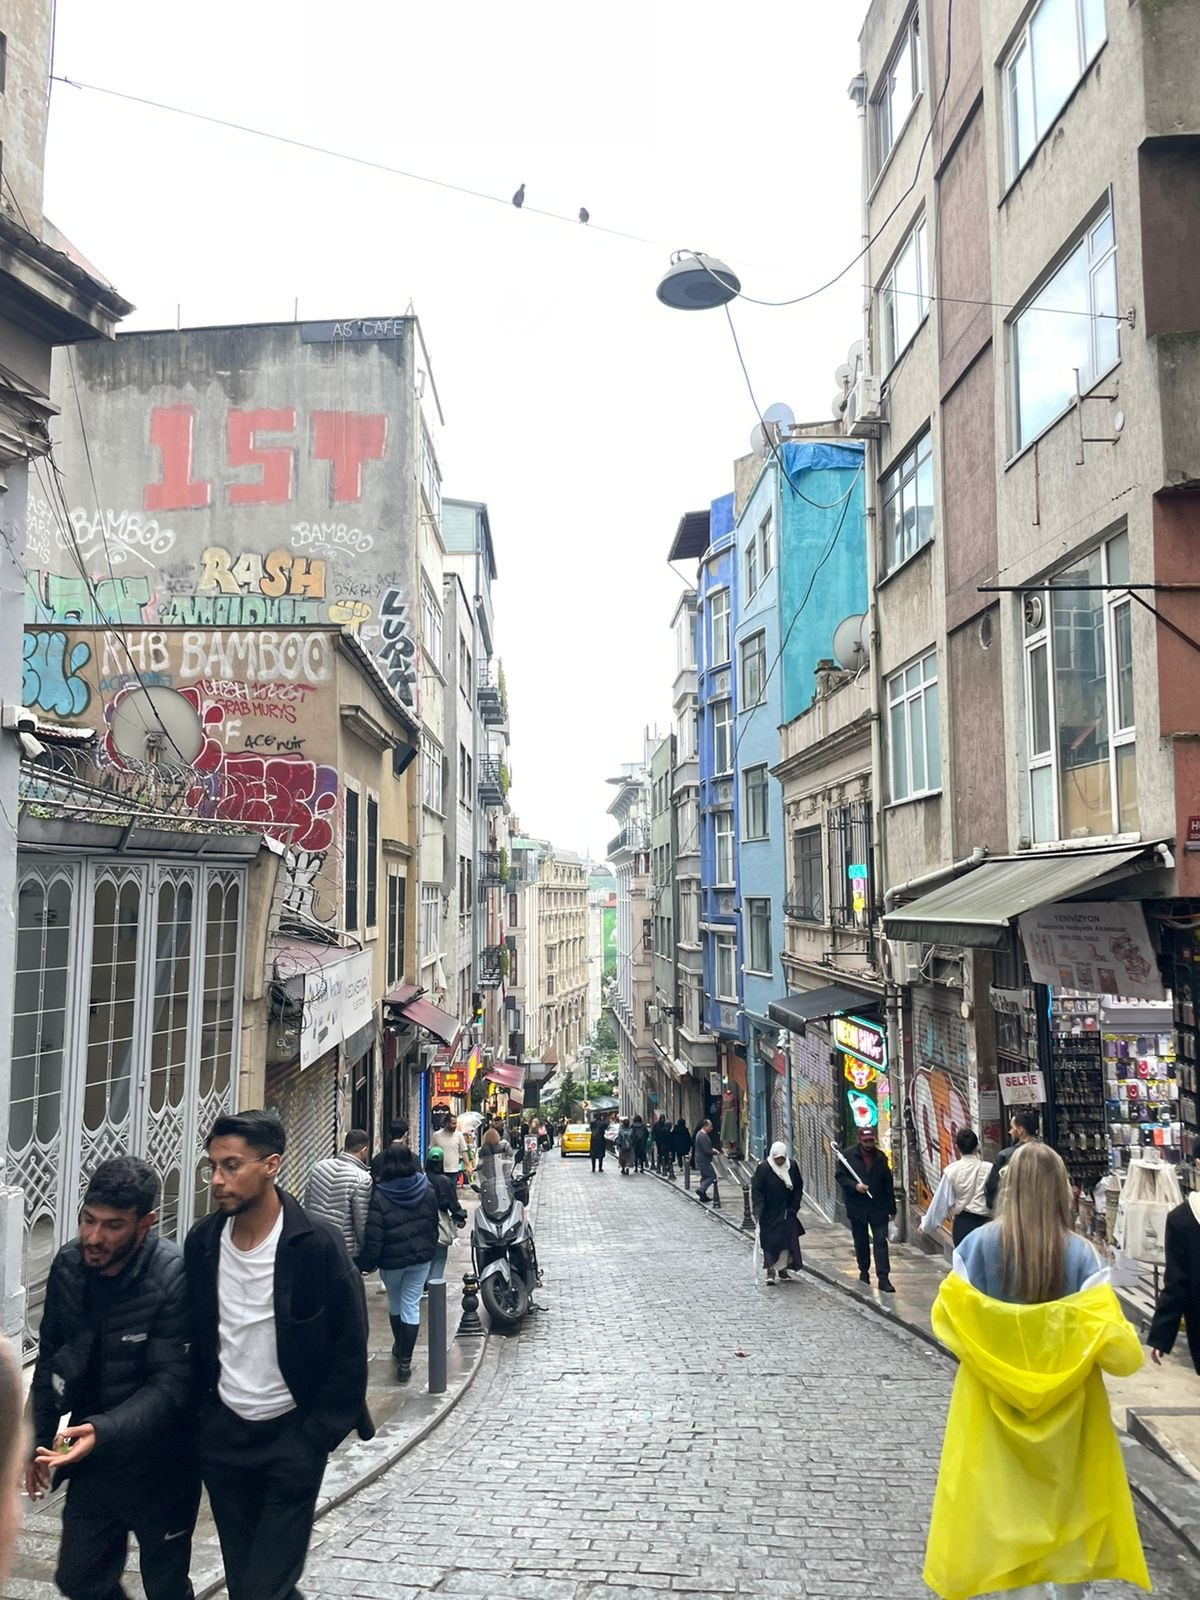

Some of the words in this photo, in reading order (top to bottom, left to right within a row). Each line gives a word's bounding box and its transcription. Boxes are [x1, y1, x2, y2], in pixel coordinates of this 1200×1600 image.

[362, 320, 404, 336] CAFE
[56, 507, 176, 554] BAMBOO
[291, 522, 374, 552] BAMBOO
[202, 547, 326, 599] RASH
[180, 631, 334, 682] BAMBOO
[378, 588, 416, 708] LURK
[1005, 1073, 1038, 1087] SELFİE
